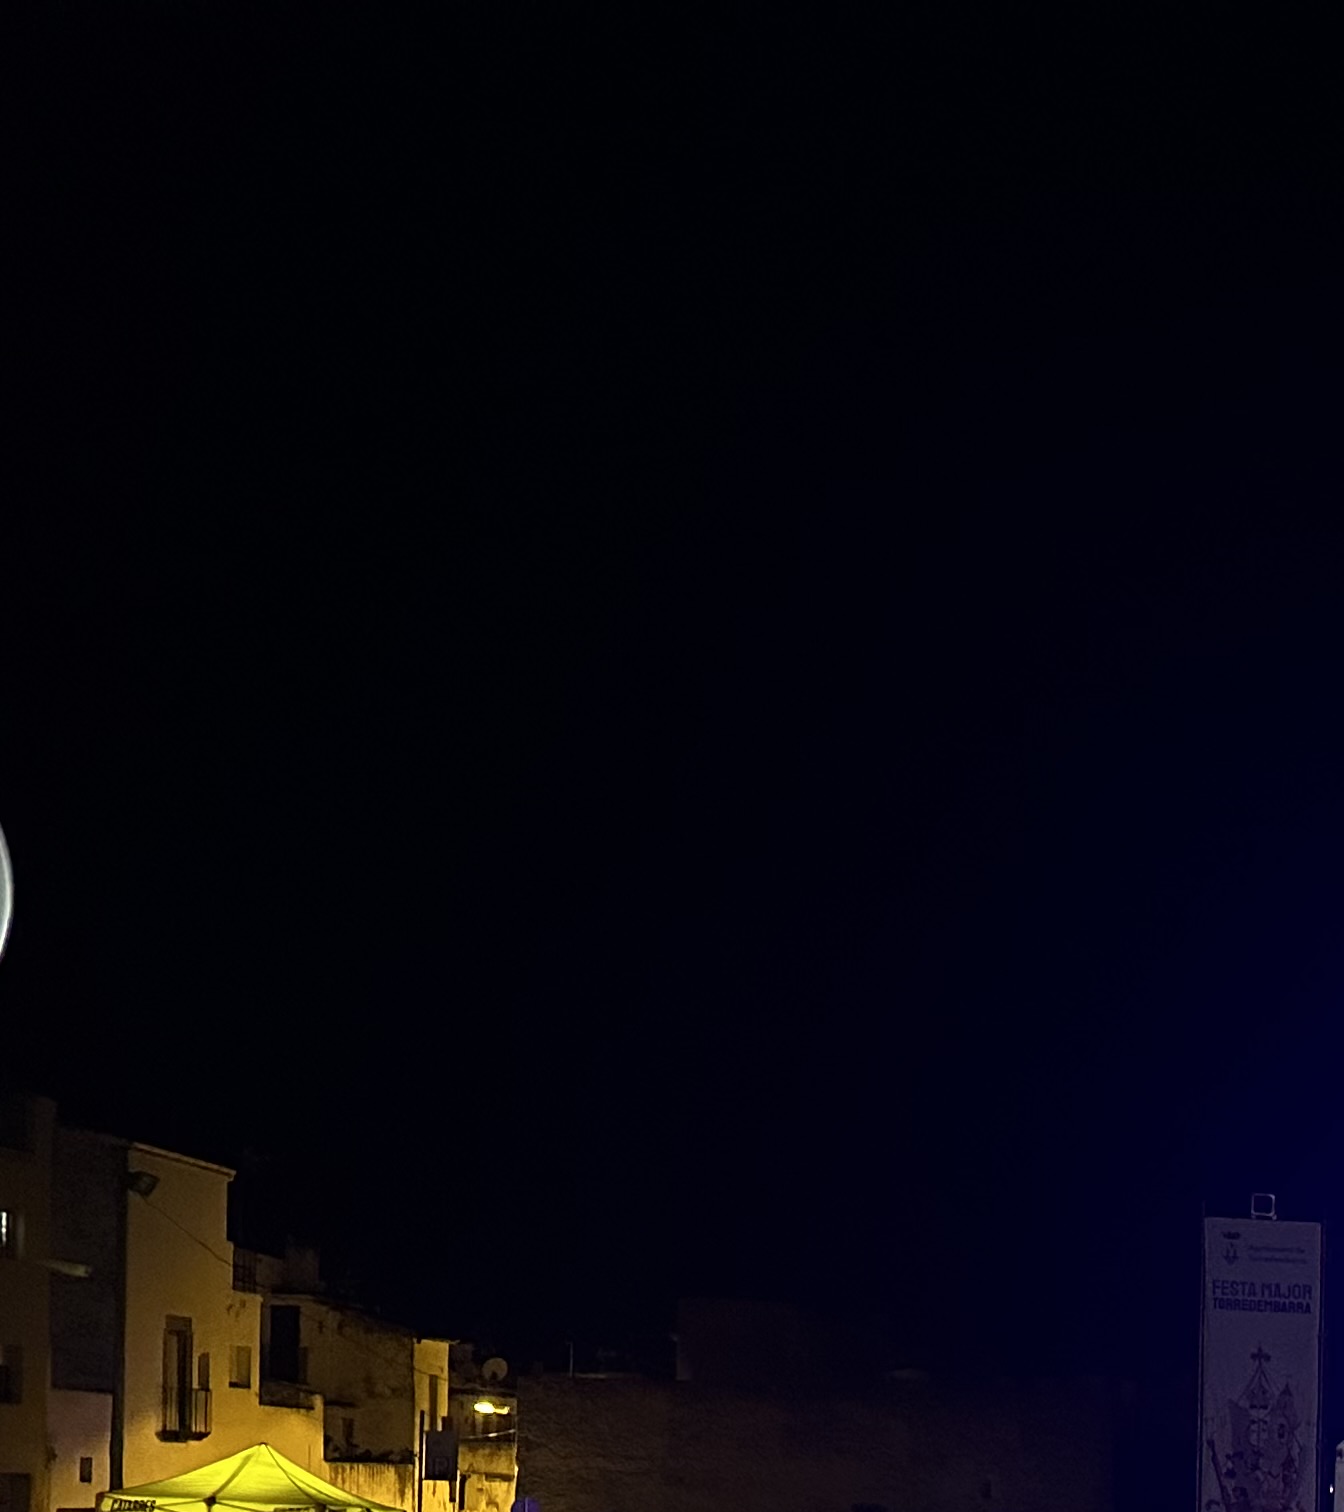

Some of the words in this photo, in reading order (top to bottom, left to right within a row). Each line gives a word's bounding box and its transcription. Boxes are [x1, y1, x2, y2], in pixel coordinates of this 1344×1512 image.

[1212, 1279, 1257, 1298] FESTA
[1261, 1282, 1313, 1300] MAJOR
[1213, 1297, 1312, 1314] TORREDEMBARRA
